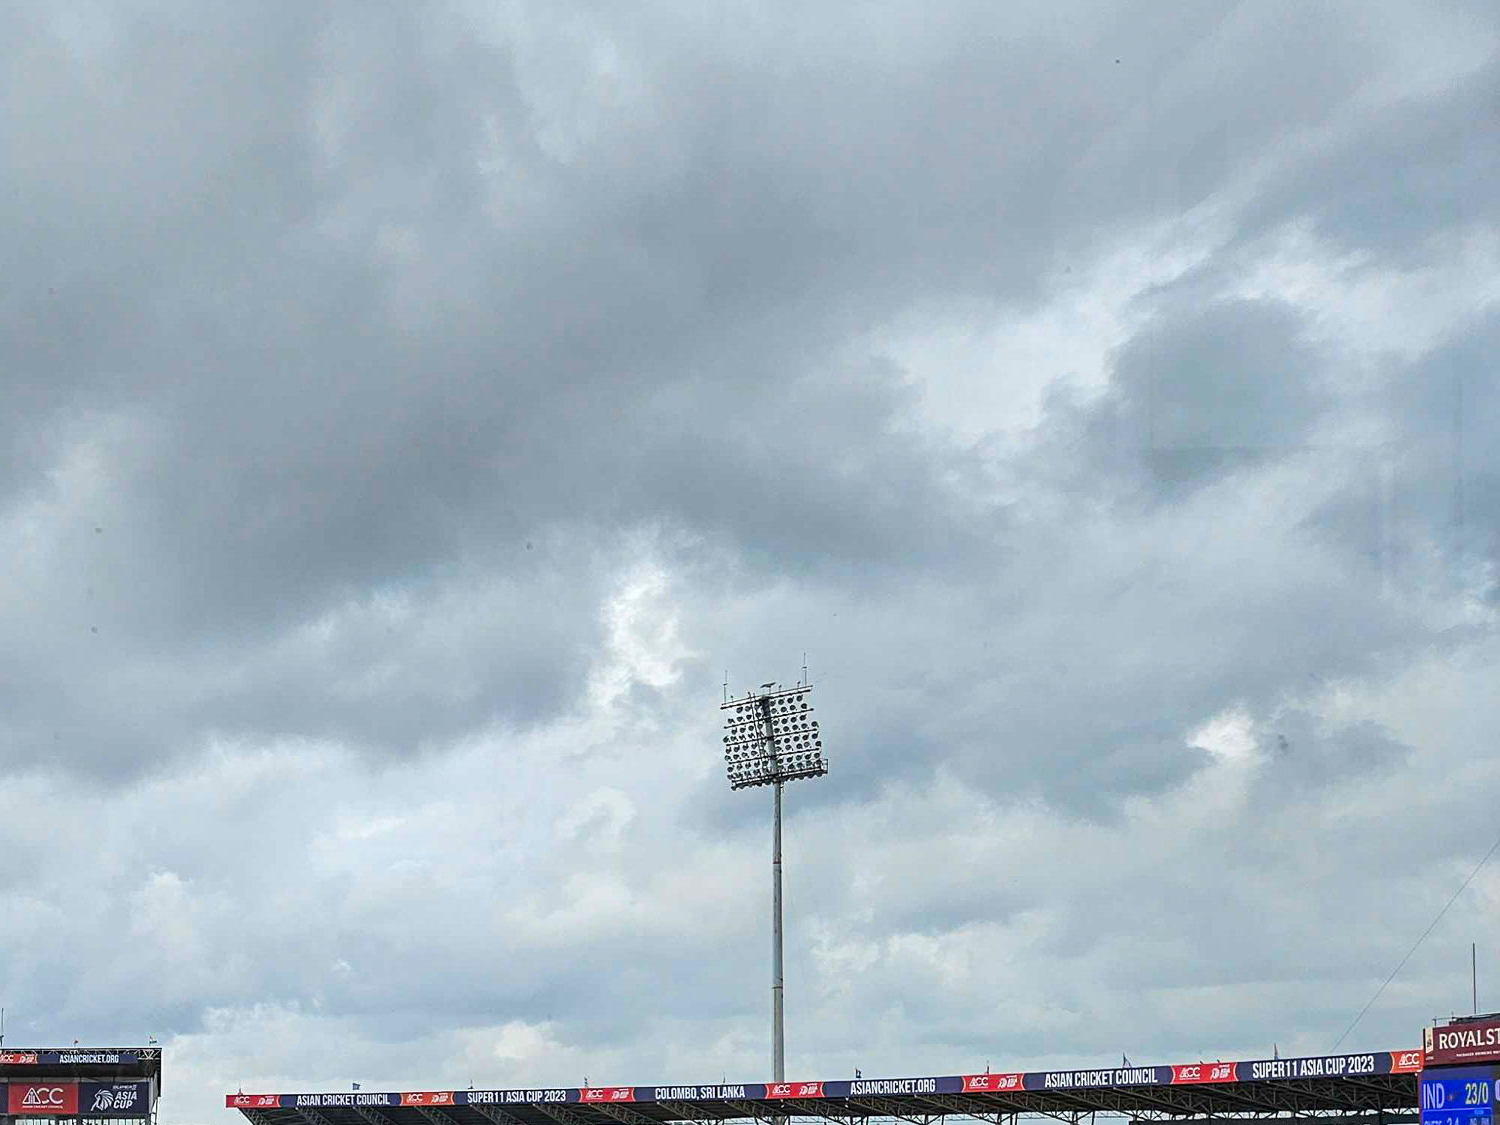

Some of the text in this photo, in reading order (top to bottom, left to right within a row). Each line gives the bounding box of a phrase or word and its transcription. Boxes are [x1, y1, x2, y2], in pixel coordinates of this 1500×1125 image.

[59, 1055, 119, 1064] ASIANCRICKET.ORG
[1253, 1055, 1375, 1079] SUPER11 ASIA CUP 2023
[1045, 1068, 1158, 1089] ASIAN CRICKET COUNCIL
[655, 1086, 745, 1100] COLOMBO, SRI LANKA
[850, 1079, 936, 1095] ASIANCRICKET.ORG
[22, 1087, 64, 1105] ACC
[115, 1091, 138, 1101] ASIA
[296, 1094, 390, 1106] ASIAN CRICKET COUNCIL
[467, 1090, 566, 1104] SUPER11 ASIA CUP 2023
[1423, 1082, 1489, 1110] IND 23/0
[113, 1100, 133, 1109] CUP
